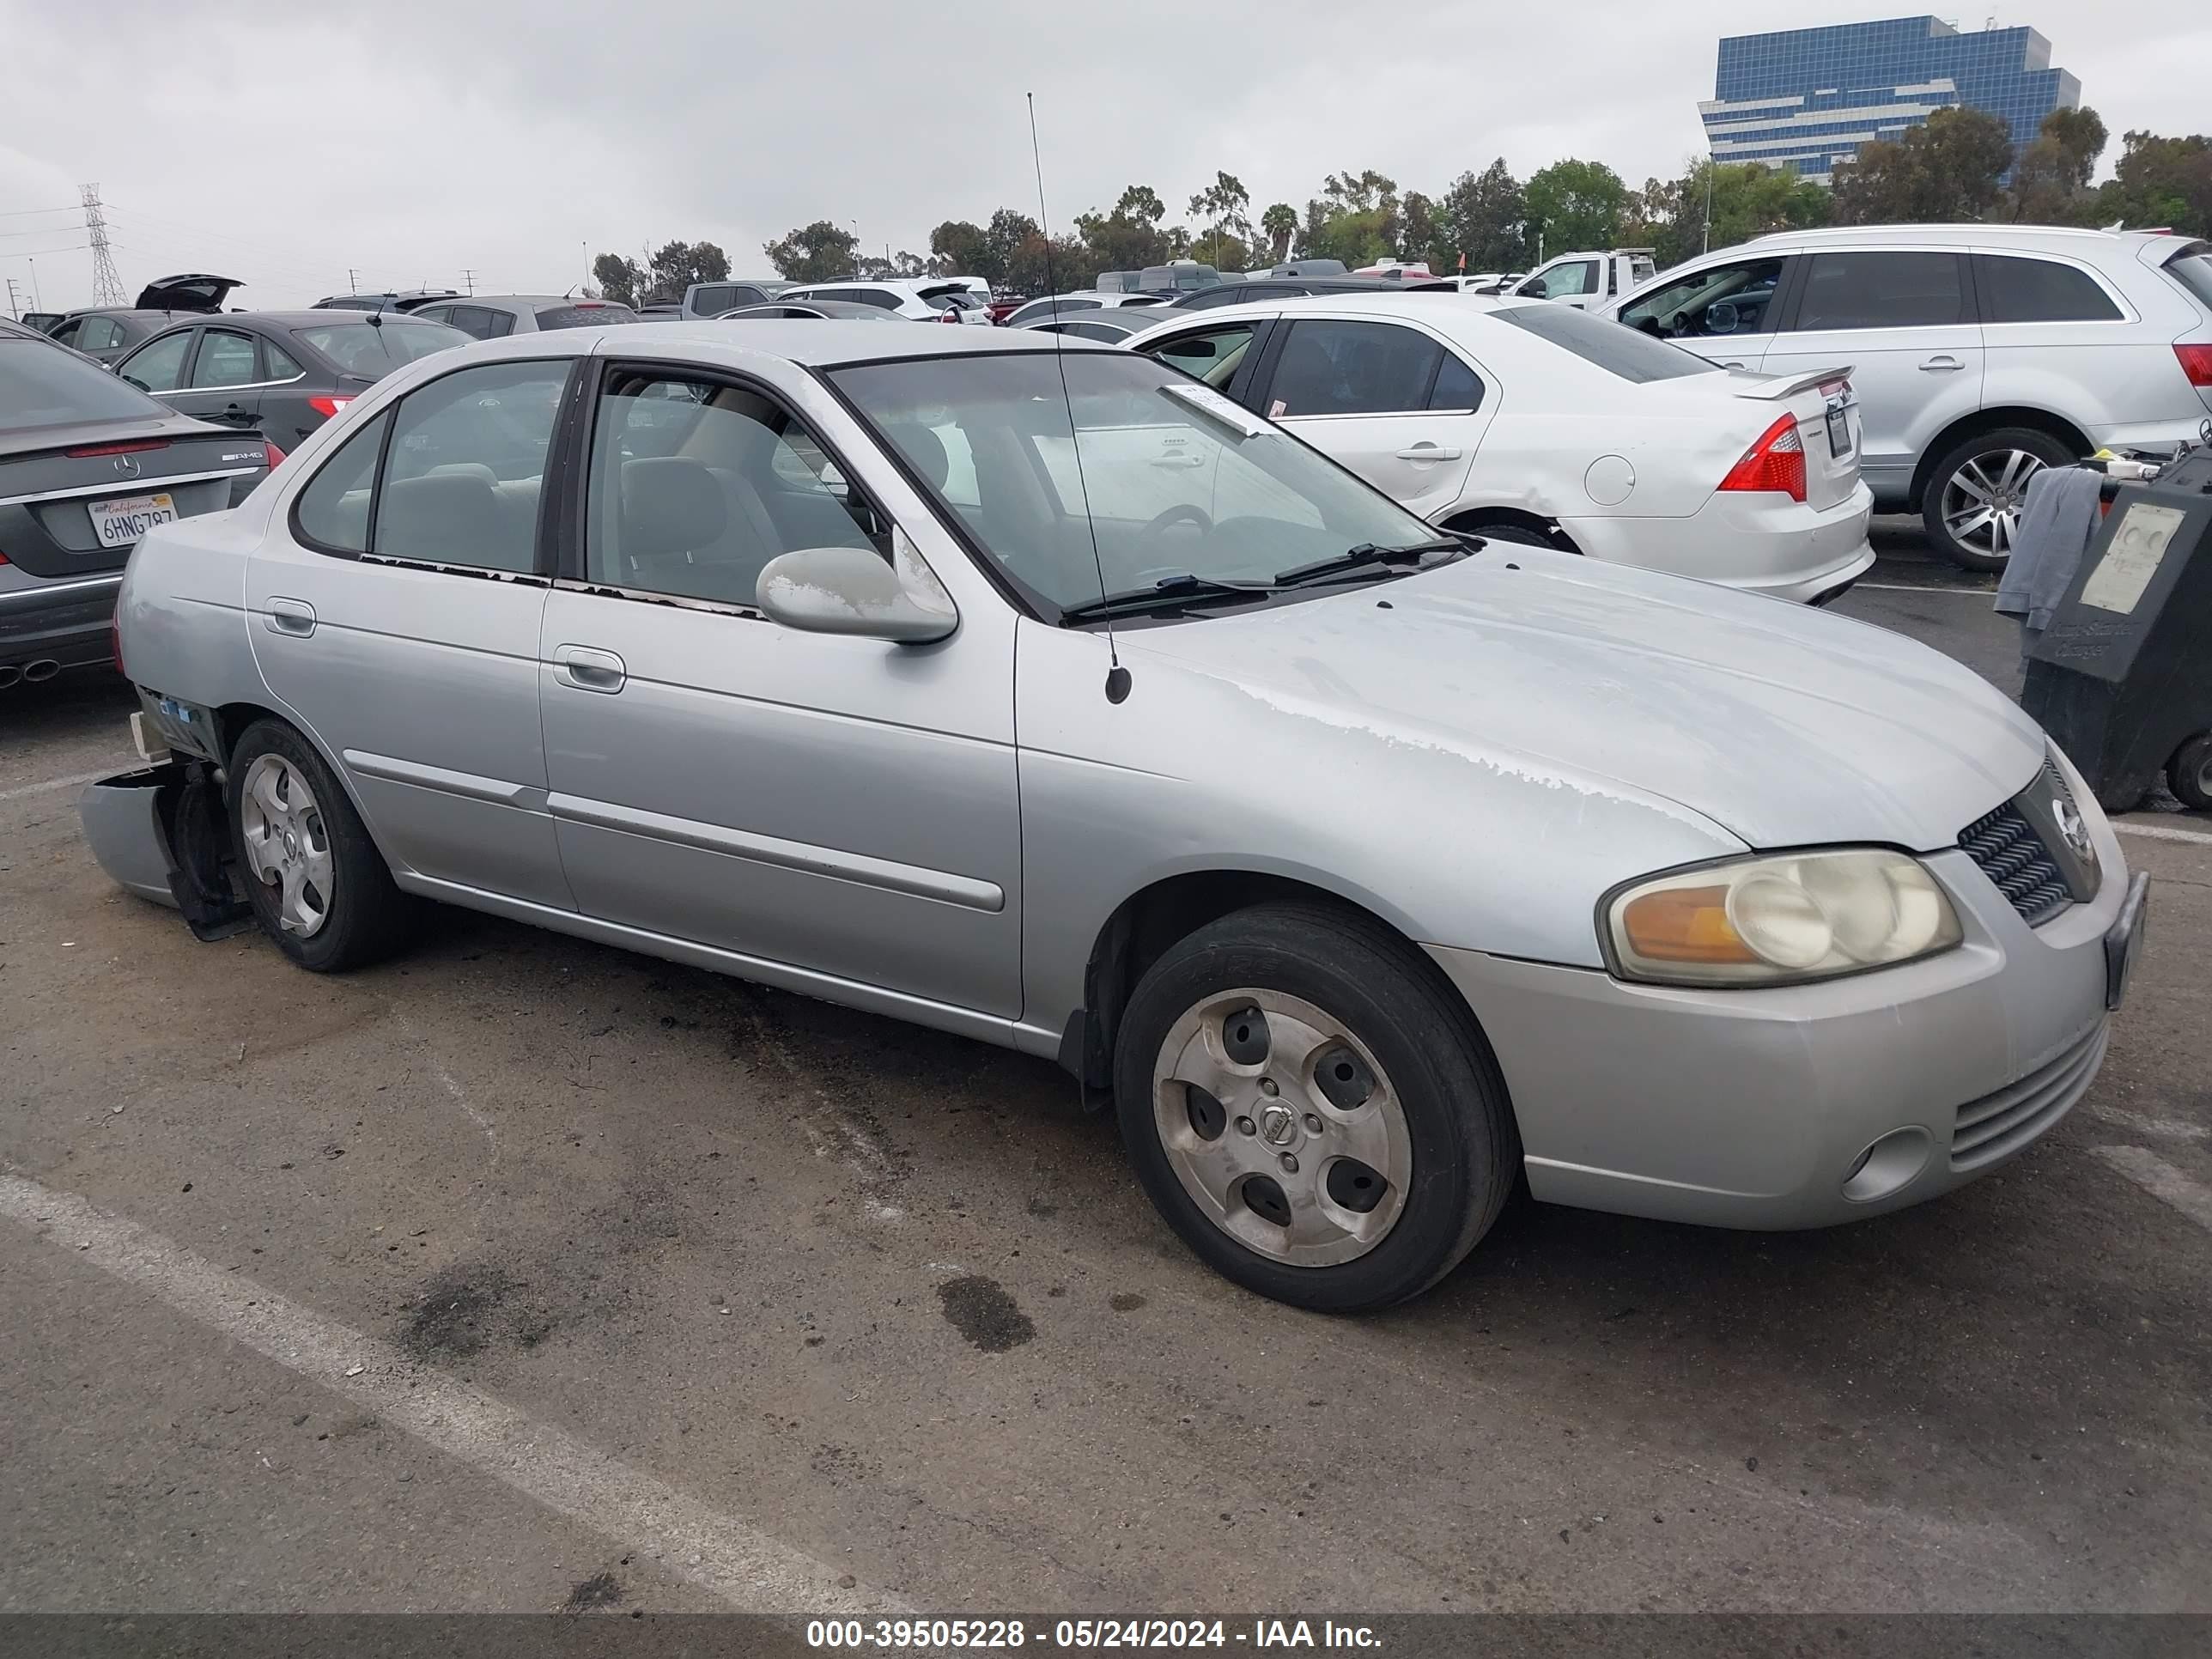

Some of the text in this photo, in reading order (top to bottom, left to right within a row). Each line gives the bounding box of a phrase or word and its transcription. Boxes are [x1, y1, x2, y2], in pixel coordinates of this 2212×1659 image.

[235, 452, 264, 460] AMG
[108, 501, 156, 515] California
[104, 510, 172, 539] 6HNG787
[1266, 1110, 1290, 1144] NISSAN
